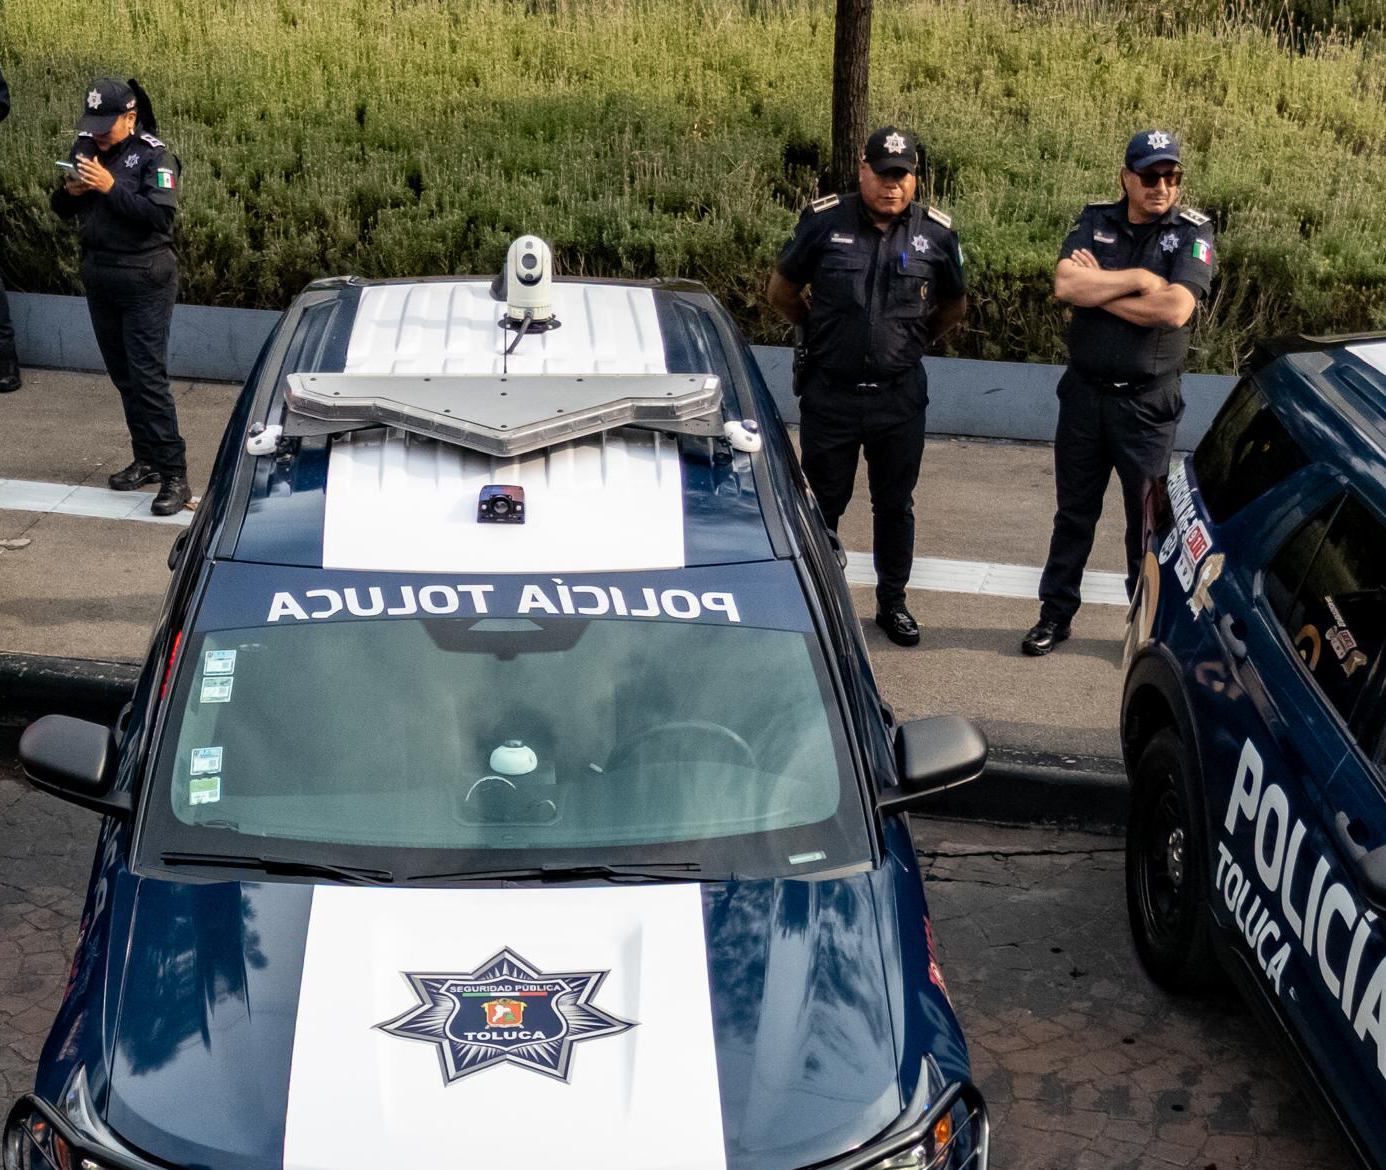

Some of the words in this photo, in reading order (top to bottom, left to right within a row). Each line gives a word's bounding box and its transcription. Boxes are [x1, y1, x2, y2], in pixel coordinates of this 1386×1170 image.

[1215, 841, 1292, 996] TOLUCA
[449, 985, 513, 993] SEGURIDAD
[515, 983, 561, 992] PÚBLICA
[464, 1030, 546, 1041] TOLUCA
